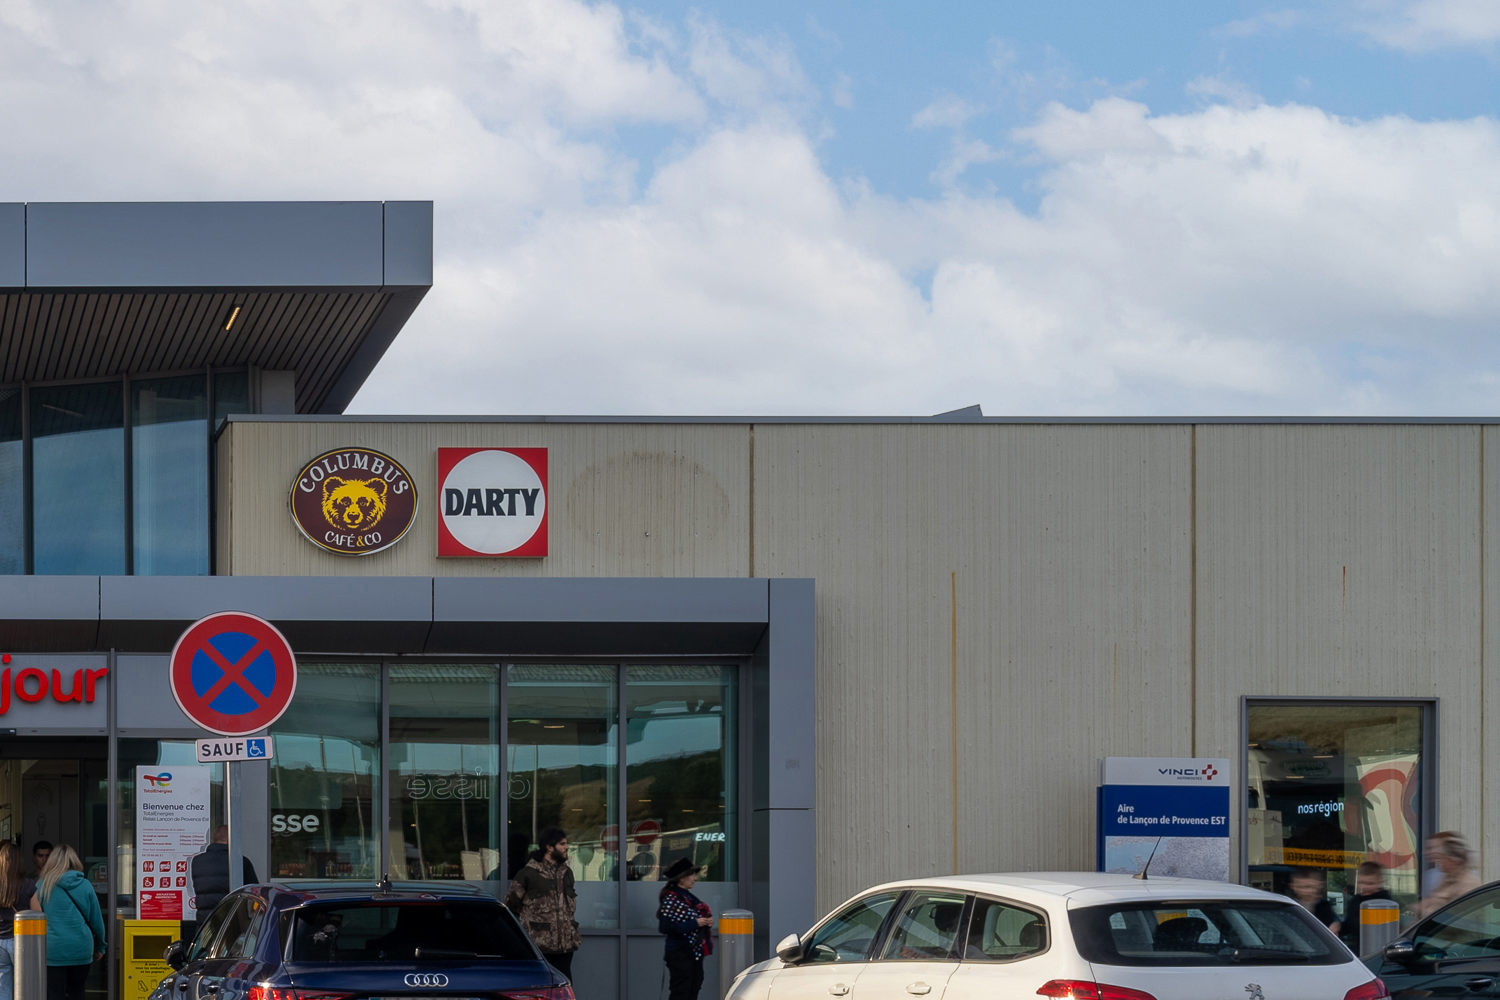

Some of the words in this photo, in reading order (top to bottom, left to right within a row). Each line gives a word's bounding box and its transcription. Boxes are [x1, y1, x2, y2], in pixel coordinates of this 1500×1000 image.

[299, 452, 409, 495] COLUMBUS
[444, 488, 540, 516] DARTY
[202, 742, 244, 757] SAUF
[1117, 804, 1134, 813] Aire
[1117, 815, 1128, 824] de
[1130, 816, 1158, 826] Lançon
[1160, 815, 1170, 824] de
[1172, 816, 1209, 825] Provence
[1211, 817, 1226, 825] EST
[695, 832, 725, 842] ENER
